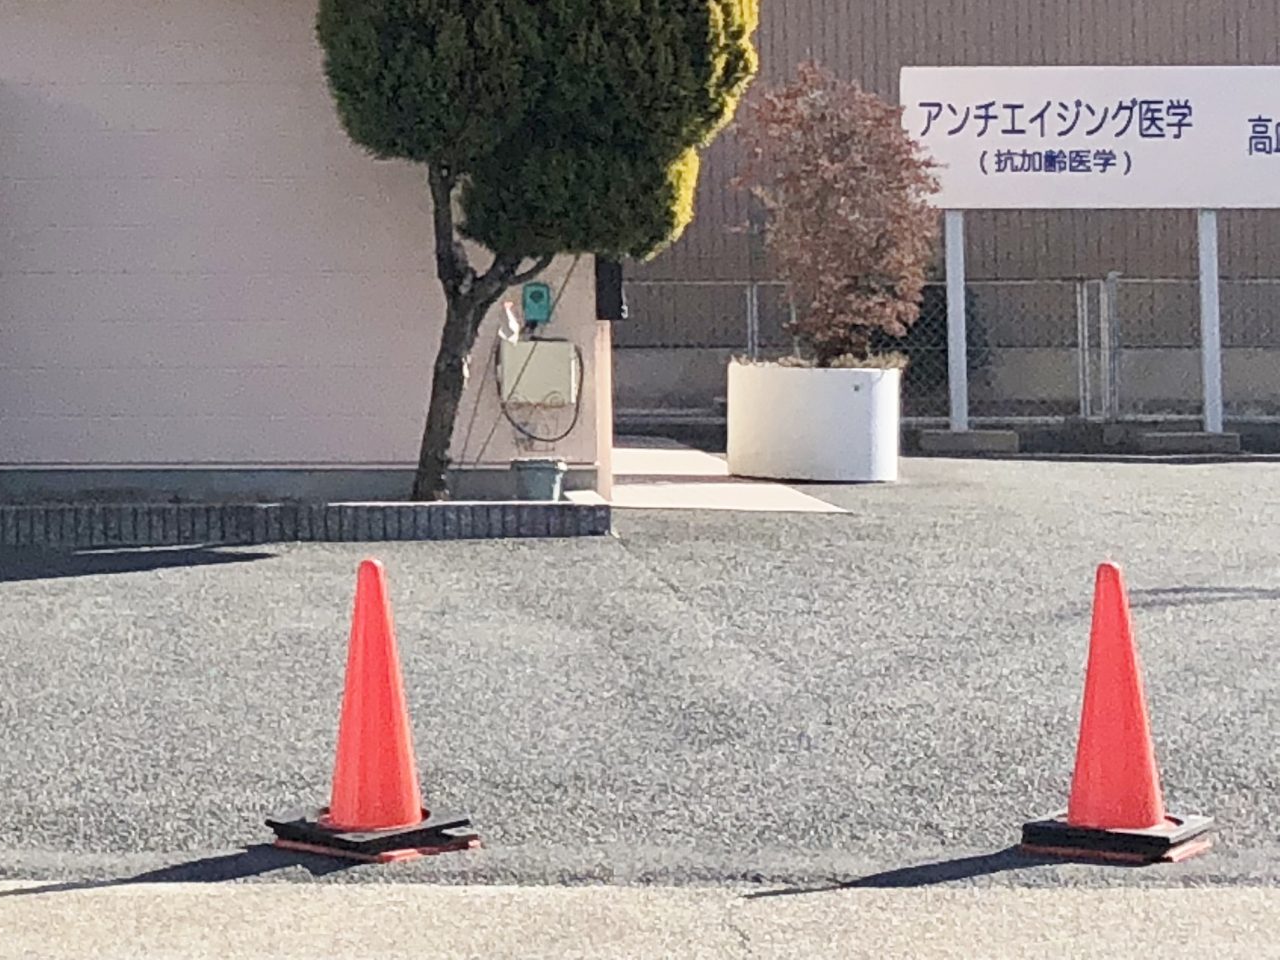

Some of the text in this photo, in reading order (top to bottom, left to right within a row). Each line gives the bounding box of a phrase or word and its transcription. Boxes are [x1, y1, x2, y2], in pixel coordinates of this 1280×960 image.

[918, 97, 1194, 140] アンチエイジング医学
[1247, 114, 1280, 156] 高
[979, 148, 1132, 176] （抗加齢医学）
